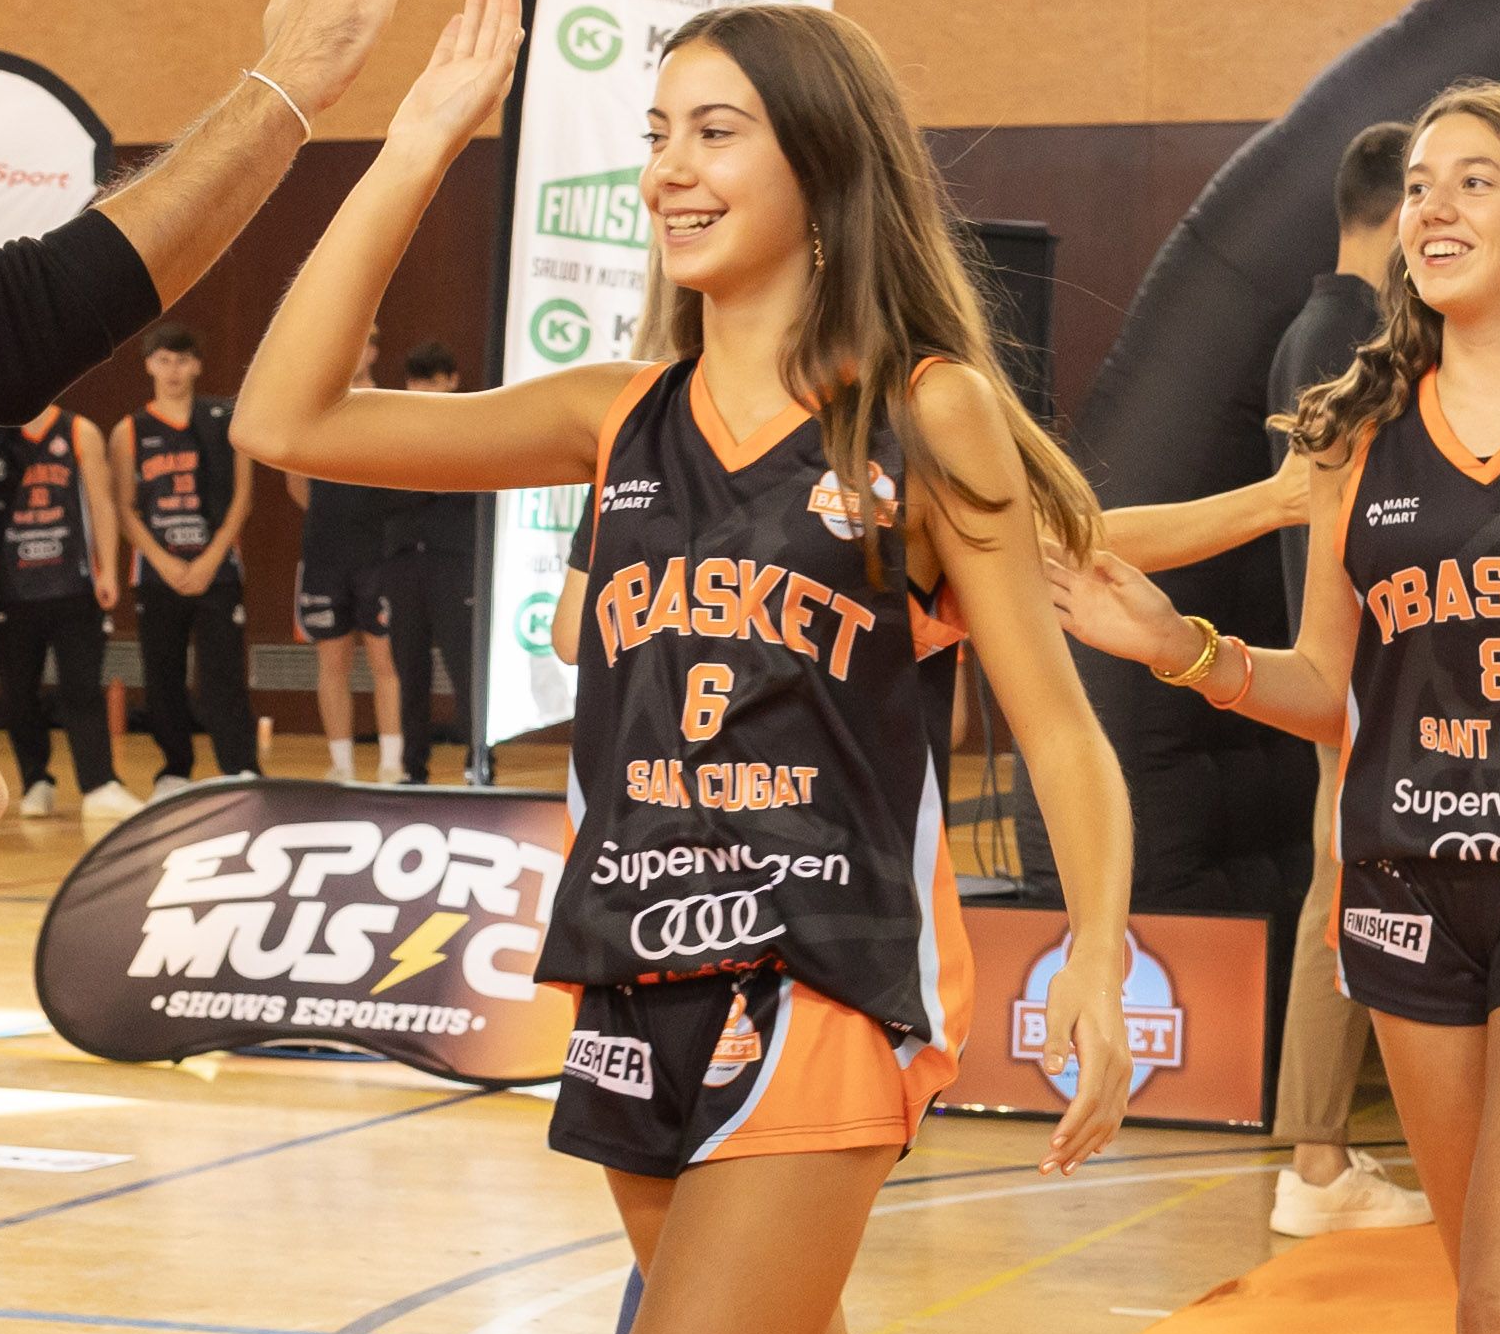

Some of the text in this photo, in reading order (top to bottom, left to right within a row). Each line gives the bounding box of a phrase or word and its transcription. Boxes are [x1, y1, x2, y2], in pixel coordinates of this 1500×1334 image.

[542, 183, 651, 244] FINIS
[610, 496, 655, 511] MART
[1381, 510, 1417, 527] MART
[1382, 496, 1420, 512] MARC
[680, 662, 735, 743] 6
[1418, 716, 1492, 761] SANT
[695, 761, 819, 813] CUGAT
[1346, 911, 1424, 953] FINISHER
[165, 990, 472, 1037] SHOWS ESPORTIUS
[1022, 1012, 1175, 1053] BET
